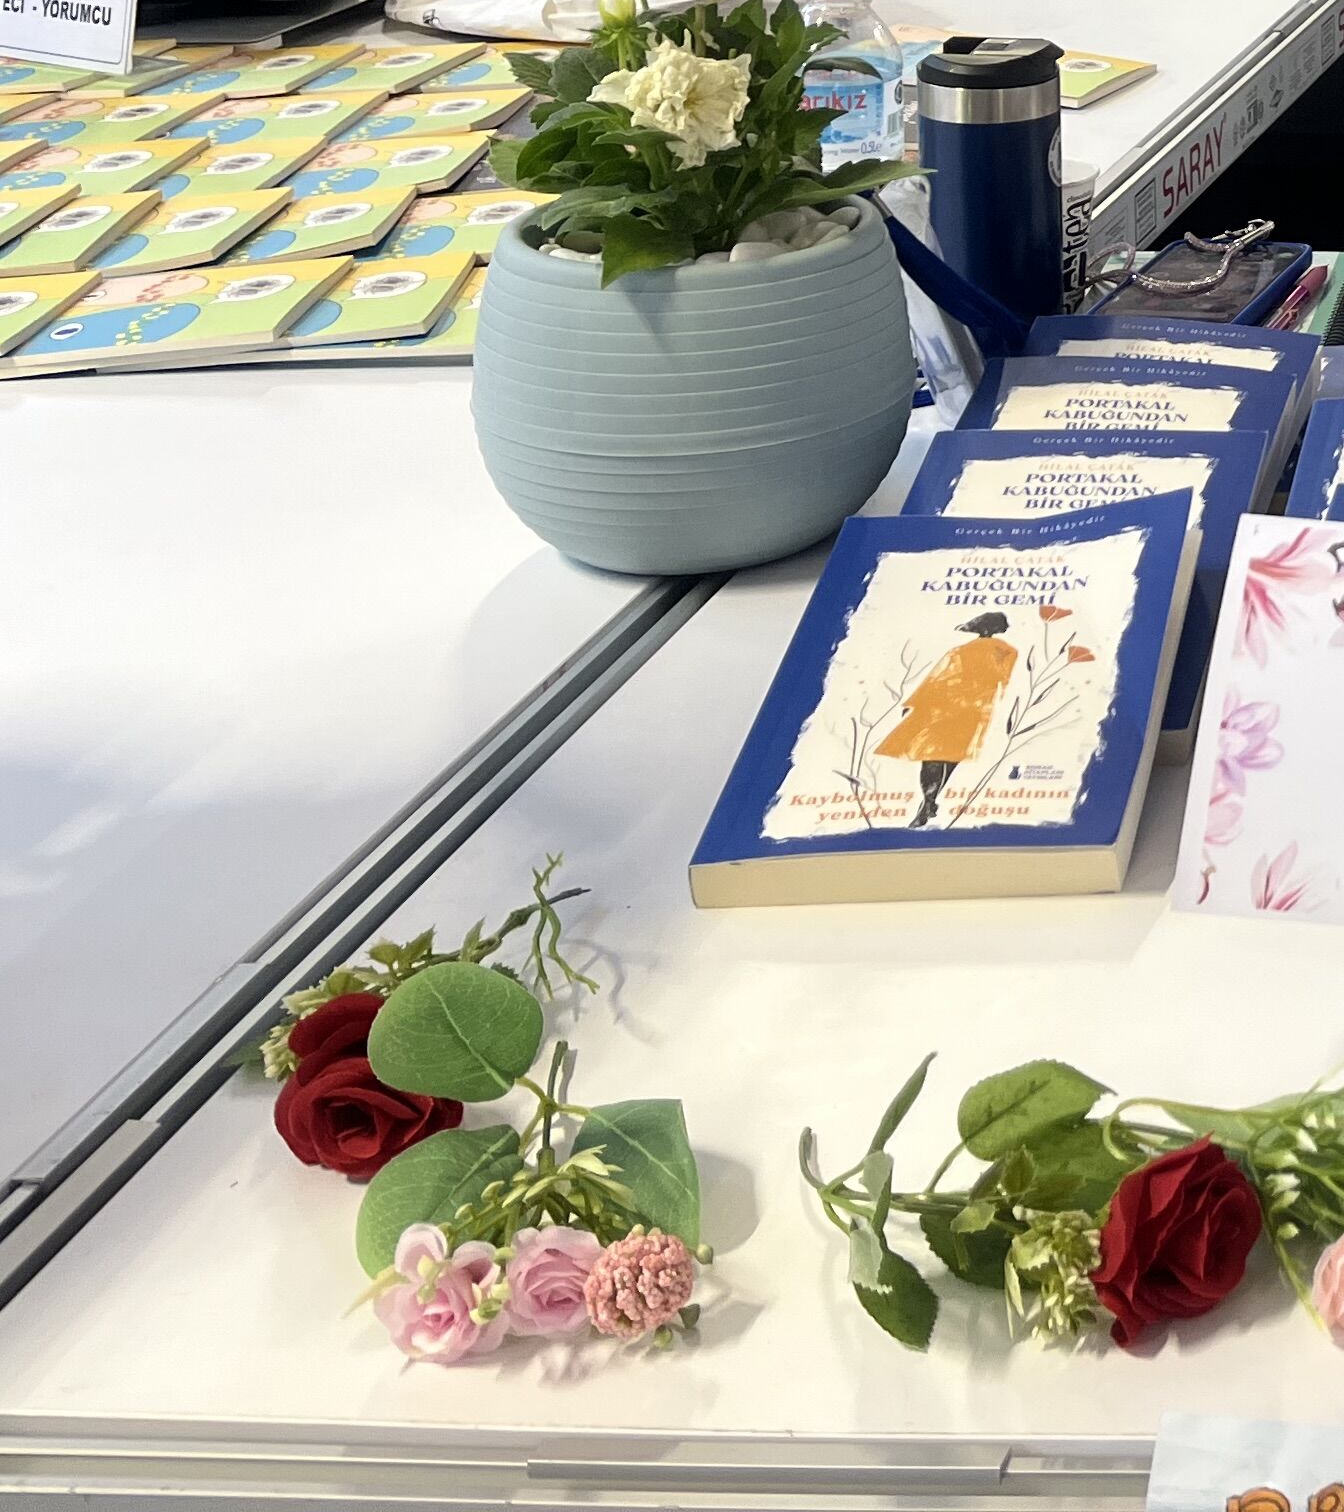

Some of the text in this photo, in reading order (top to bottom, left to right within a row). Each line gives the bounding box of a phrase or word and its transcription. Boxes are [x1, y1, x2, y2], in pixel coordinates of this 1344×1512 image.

[798, 90, 867, 111] arıkız
[1162, 120, 1225, 219] SARAY
[1065, 397, 1176, 410] PORTAKAL
[1044, 408, 1189, 423] KABUĞUNDAN
[1025, 472, 1144, 485] PORTAKAL
[1002, 483, 1157, 498] KABUĞUNDAN
[1024, 497, 1062, 509] BİR
[946, 564, 1073, 578] PORTAKAL
[921, 575, 1090, 592] KABUĞUNDAN
[945, 591, 1058, 606] BİR GEMİ
[789, 787, 1071, 807] Kaybolmuş bir kadının
[815, 803, 1031, 824] yeniden doğuşu
